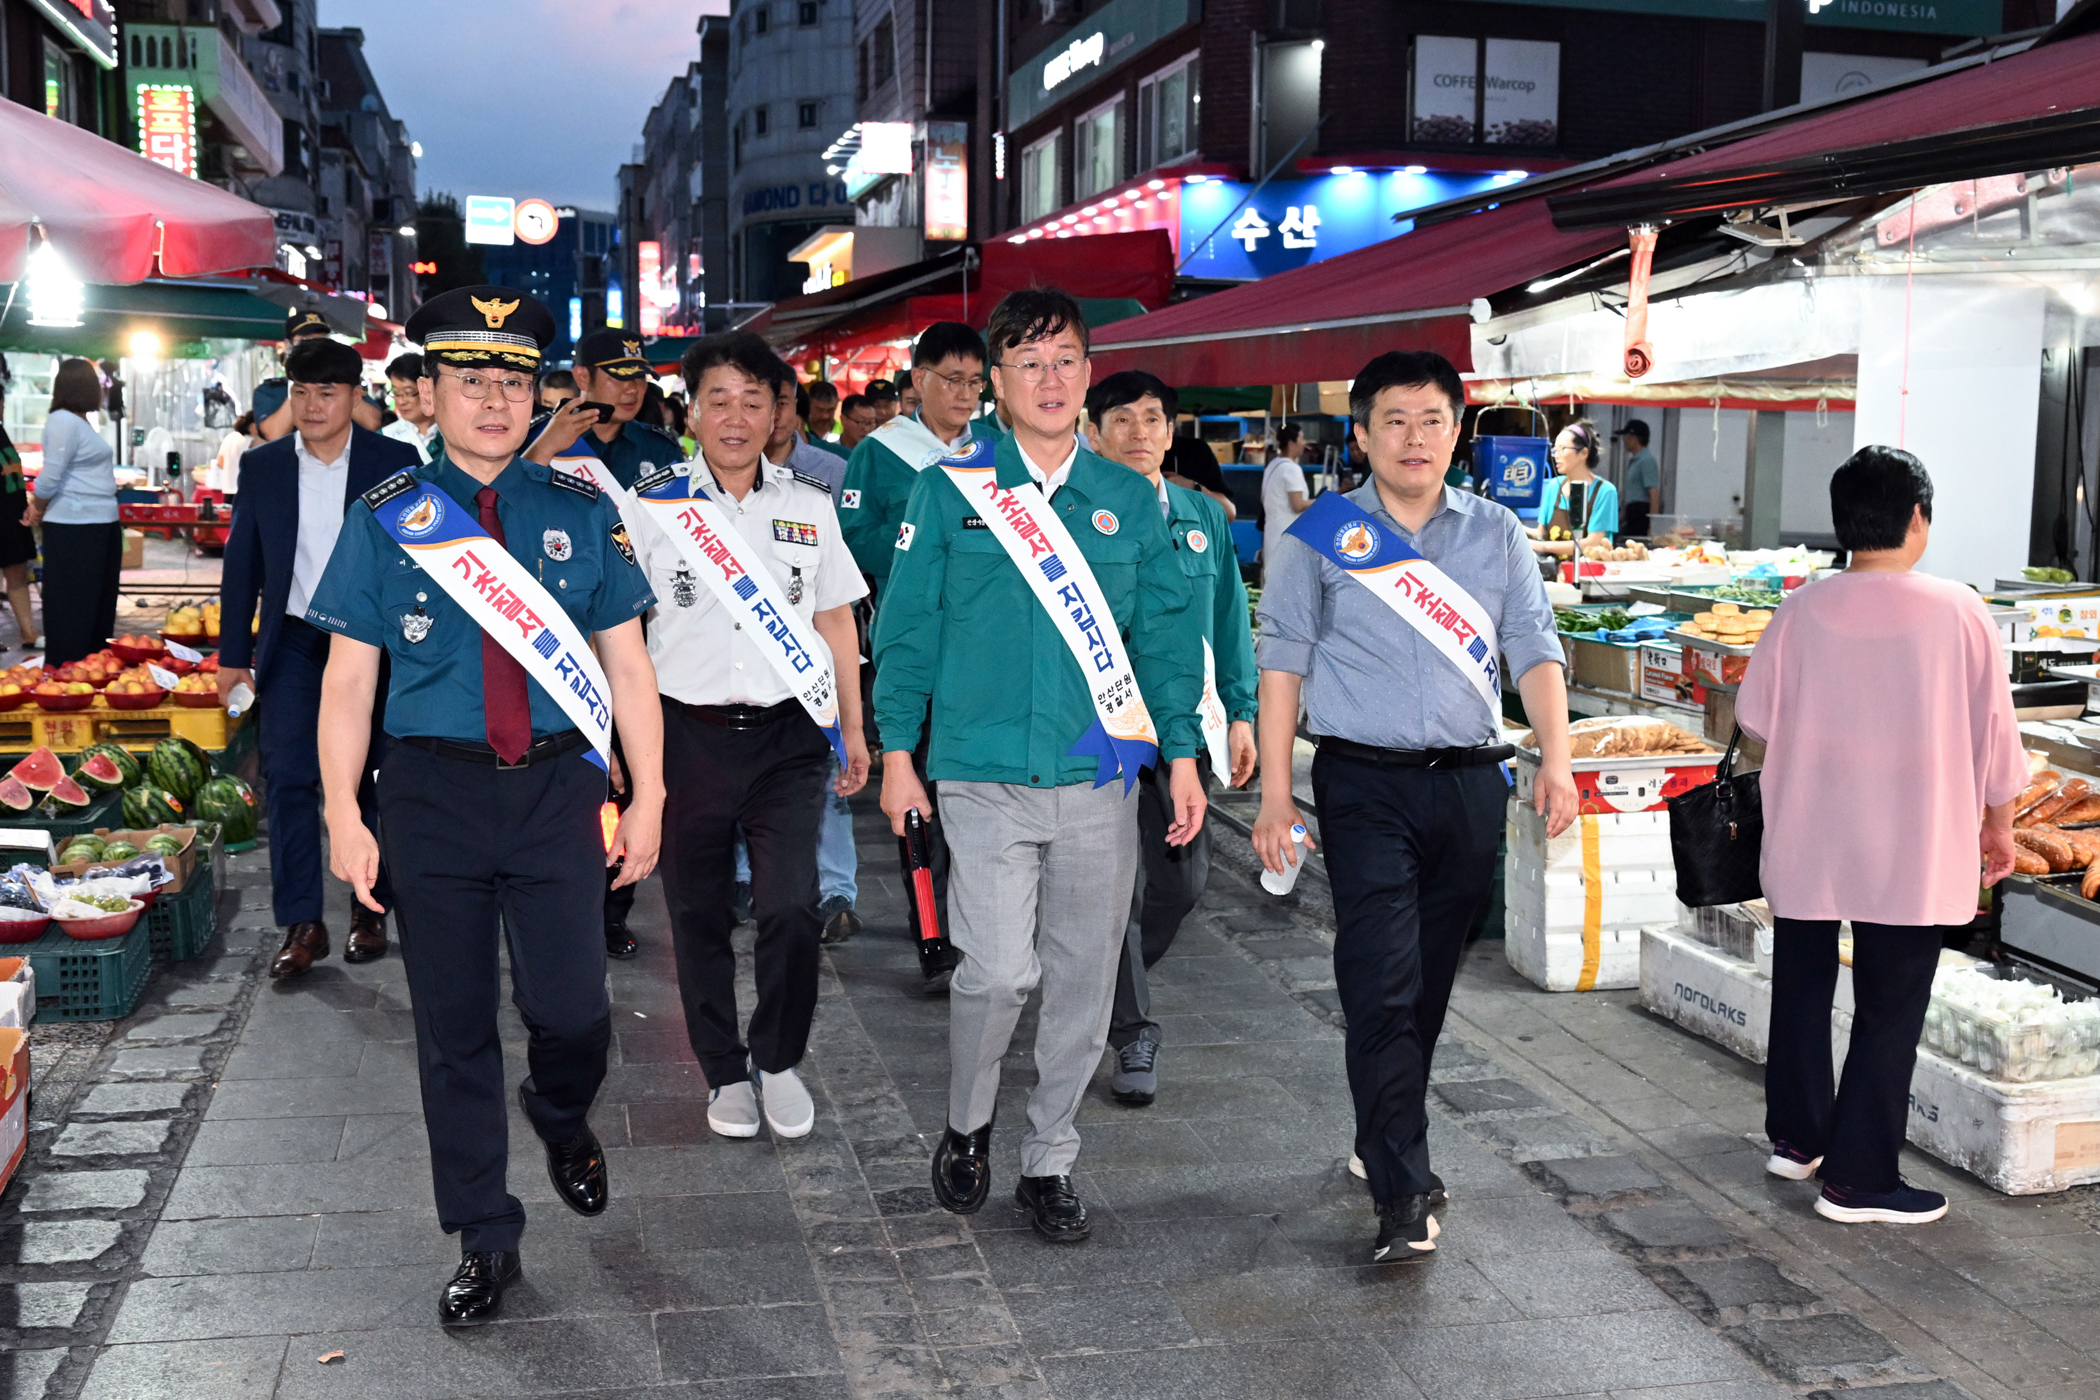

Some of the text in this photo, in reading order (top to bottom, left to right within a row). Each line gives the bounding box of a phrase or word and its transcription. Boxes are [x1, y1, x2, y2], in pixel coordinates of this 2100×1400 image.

[1841, 0, 1937, 19] INDONESIA
[1433, 74, 1536, 93] COFFE Warcop
[1231, 205, 1321, 252] 수산
[677, 506, 814, 674] 기초질서를 지킵시다
[452, 549, 610, 732] 기초질서를 지킵시다
[1056, 581, 1115, 673] 지킵시다
[1394, 571, 1489, 664] 기초질서를
[1097, 673, 1132, 705] 안산단원
[1105, 688, 1133, 714] 경찰서
